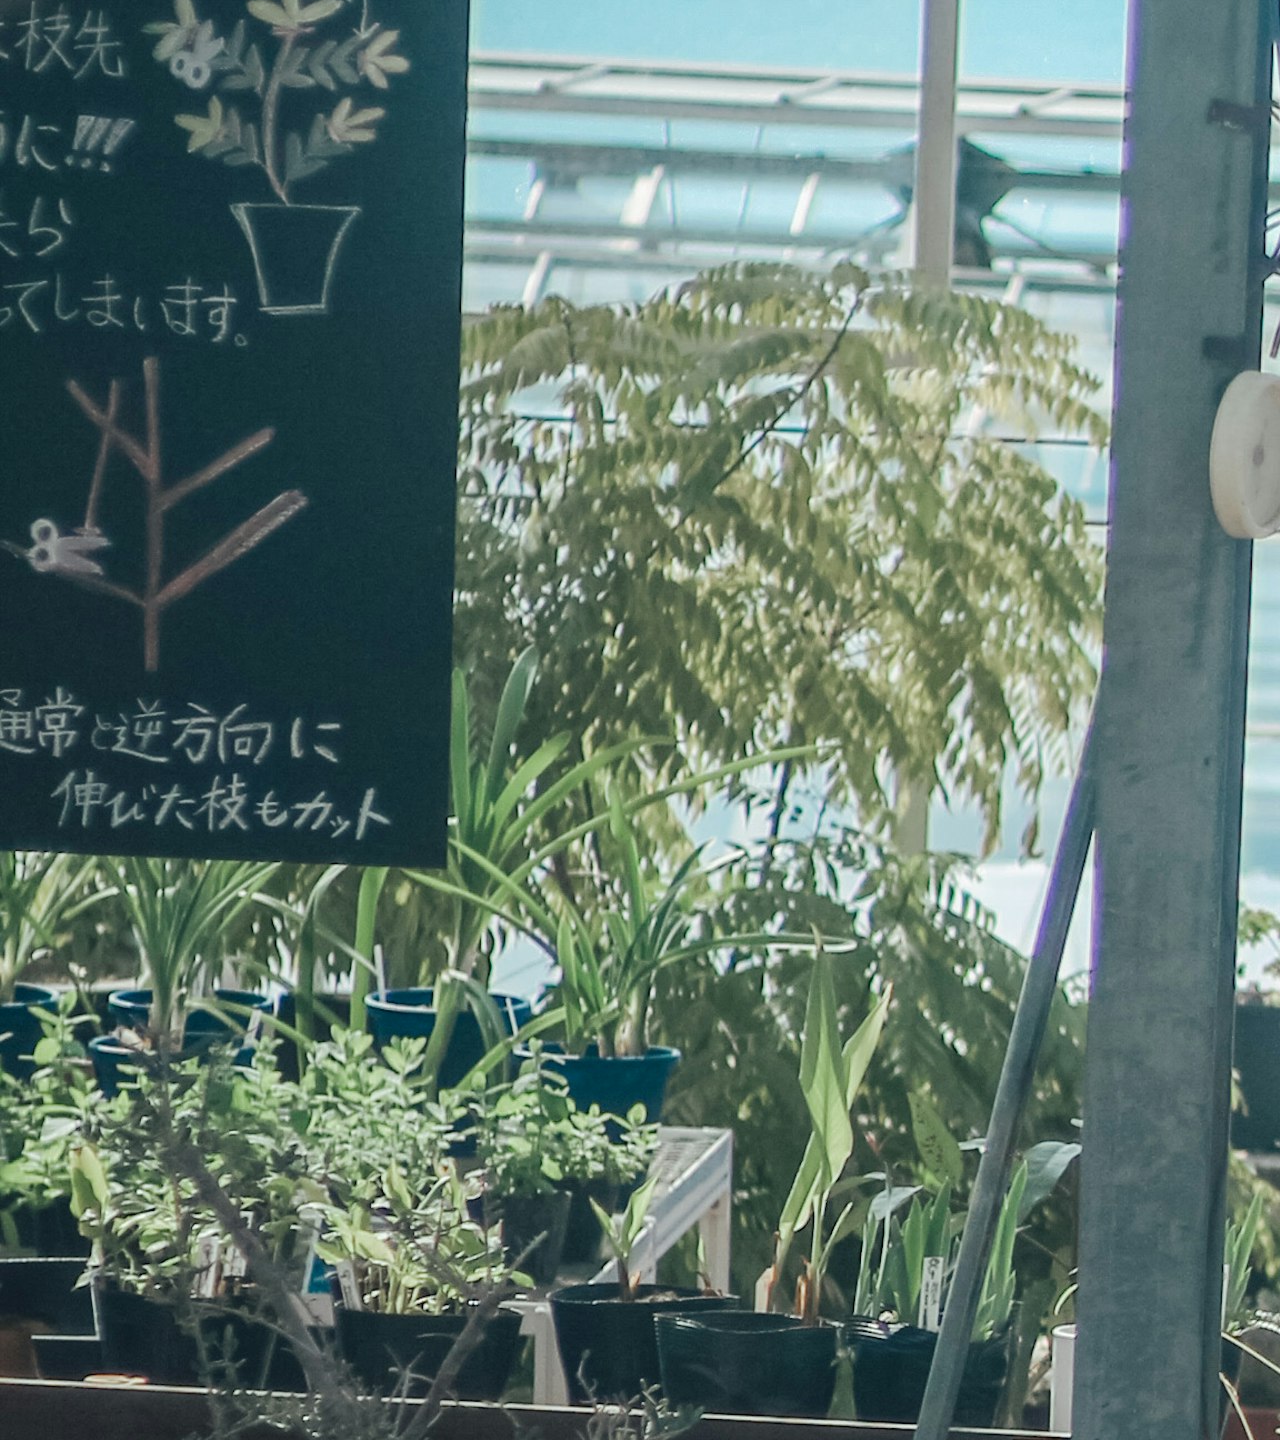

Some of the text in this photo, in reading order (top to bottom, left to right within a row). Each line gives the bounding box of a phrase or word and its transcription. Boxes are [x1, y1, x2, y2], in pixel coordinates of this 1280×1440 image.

[50, 769, 392, 842] 伸びた枝もカット
